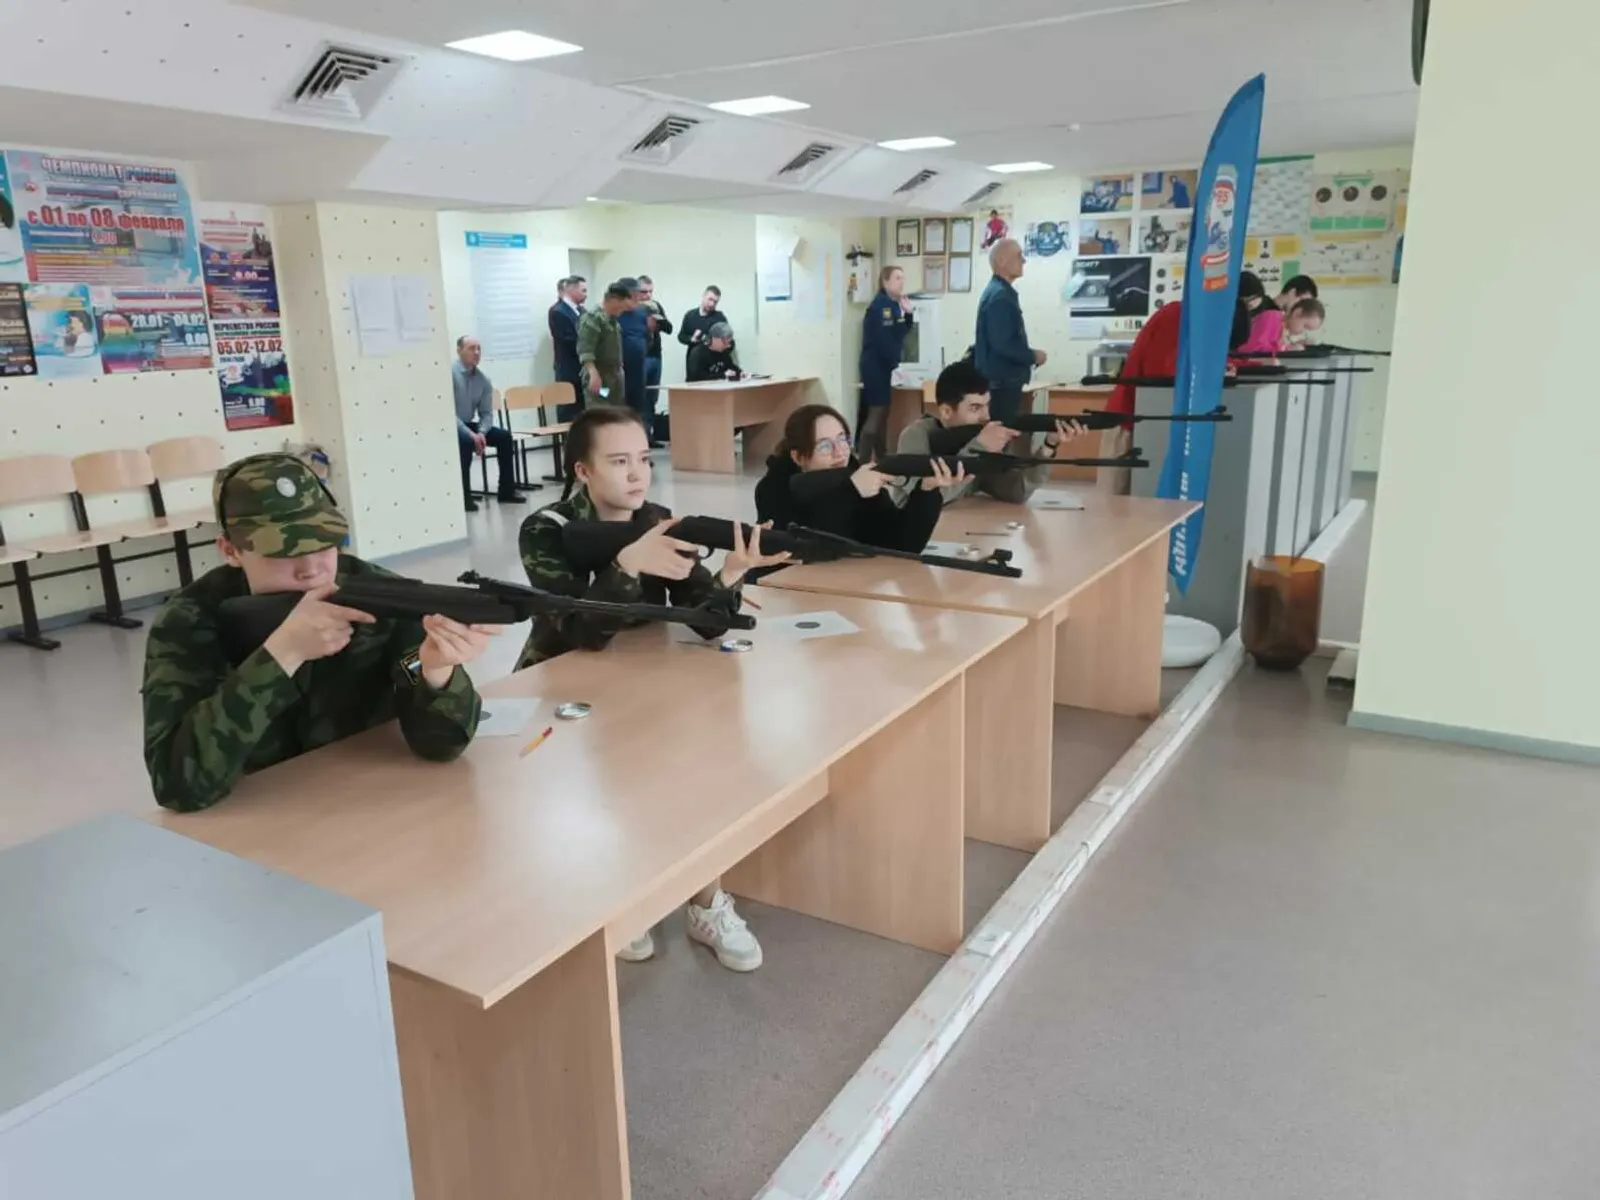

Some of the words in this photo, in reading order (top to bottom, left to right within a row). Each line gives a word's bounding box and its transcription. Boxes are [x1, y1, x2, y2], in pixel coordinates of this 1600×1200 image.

[41, 157, 123, 181] ЧЕМПИОНАТ
[41, 204, 63, 225] 01
[67, 212, 87, 227] по
[90, 207, 115, 227] 08
[117, 213, 185, 231] февраля
